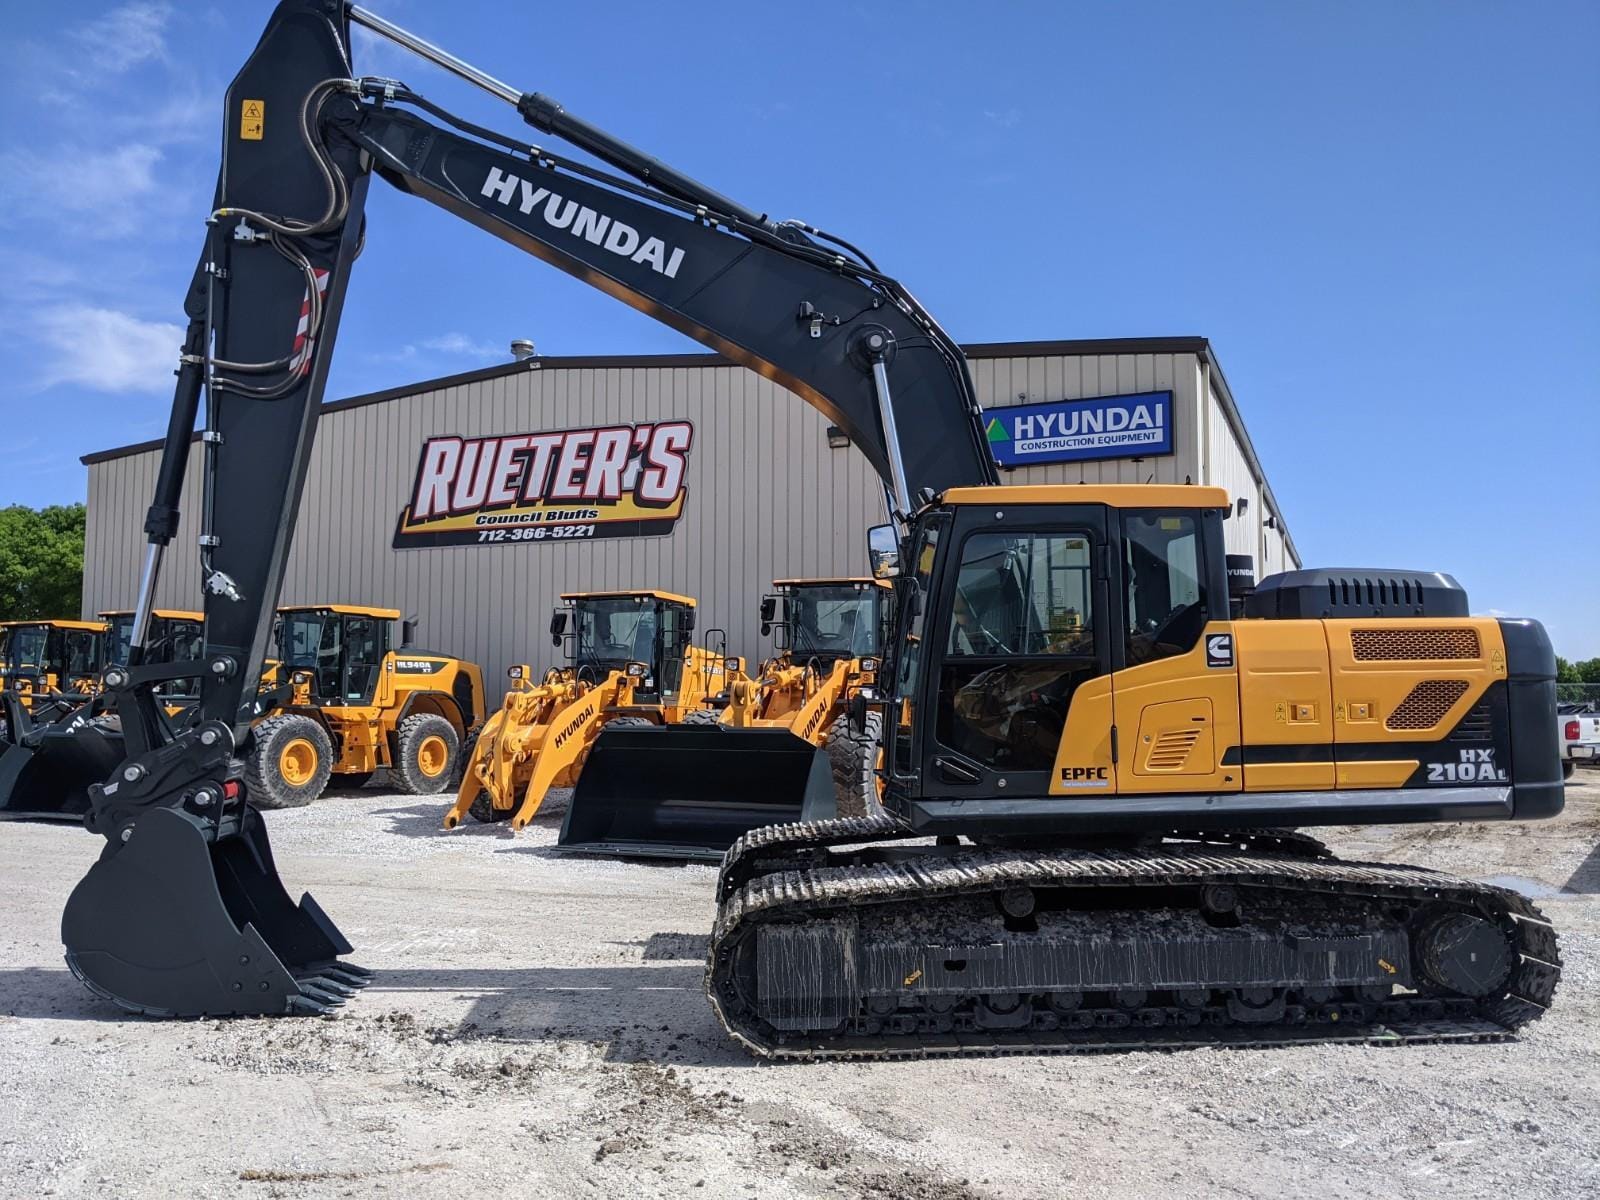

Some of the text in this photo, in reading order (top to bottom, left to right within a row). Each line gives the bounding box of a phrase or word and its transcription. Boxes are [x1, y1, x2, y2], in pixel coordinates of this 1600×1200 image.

[480, 166, 686, 279] HYUNDAI
[1014, 403, 1164, 440] HYUNDAI
[1020, 432, 1156, 451] CONSTRUCTION EQUIPMENT
[411, 421, 694, 521] RUETER'S
[475, 508, 599, 525] Council Bluffs
[477, 525, 596, 543] 712-366-5221
[554, 703, 595, 749] HYUNDAI
[1459, 748, 1493, 763] HX
[1061, 767, 1108, 780] EPFC
